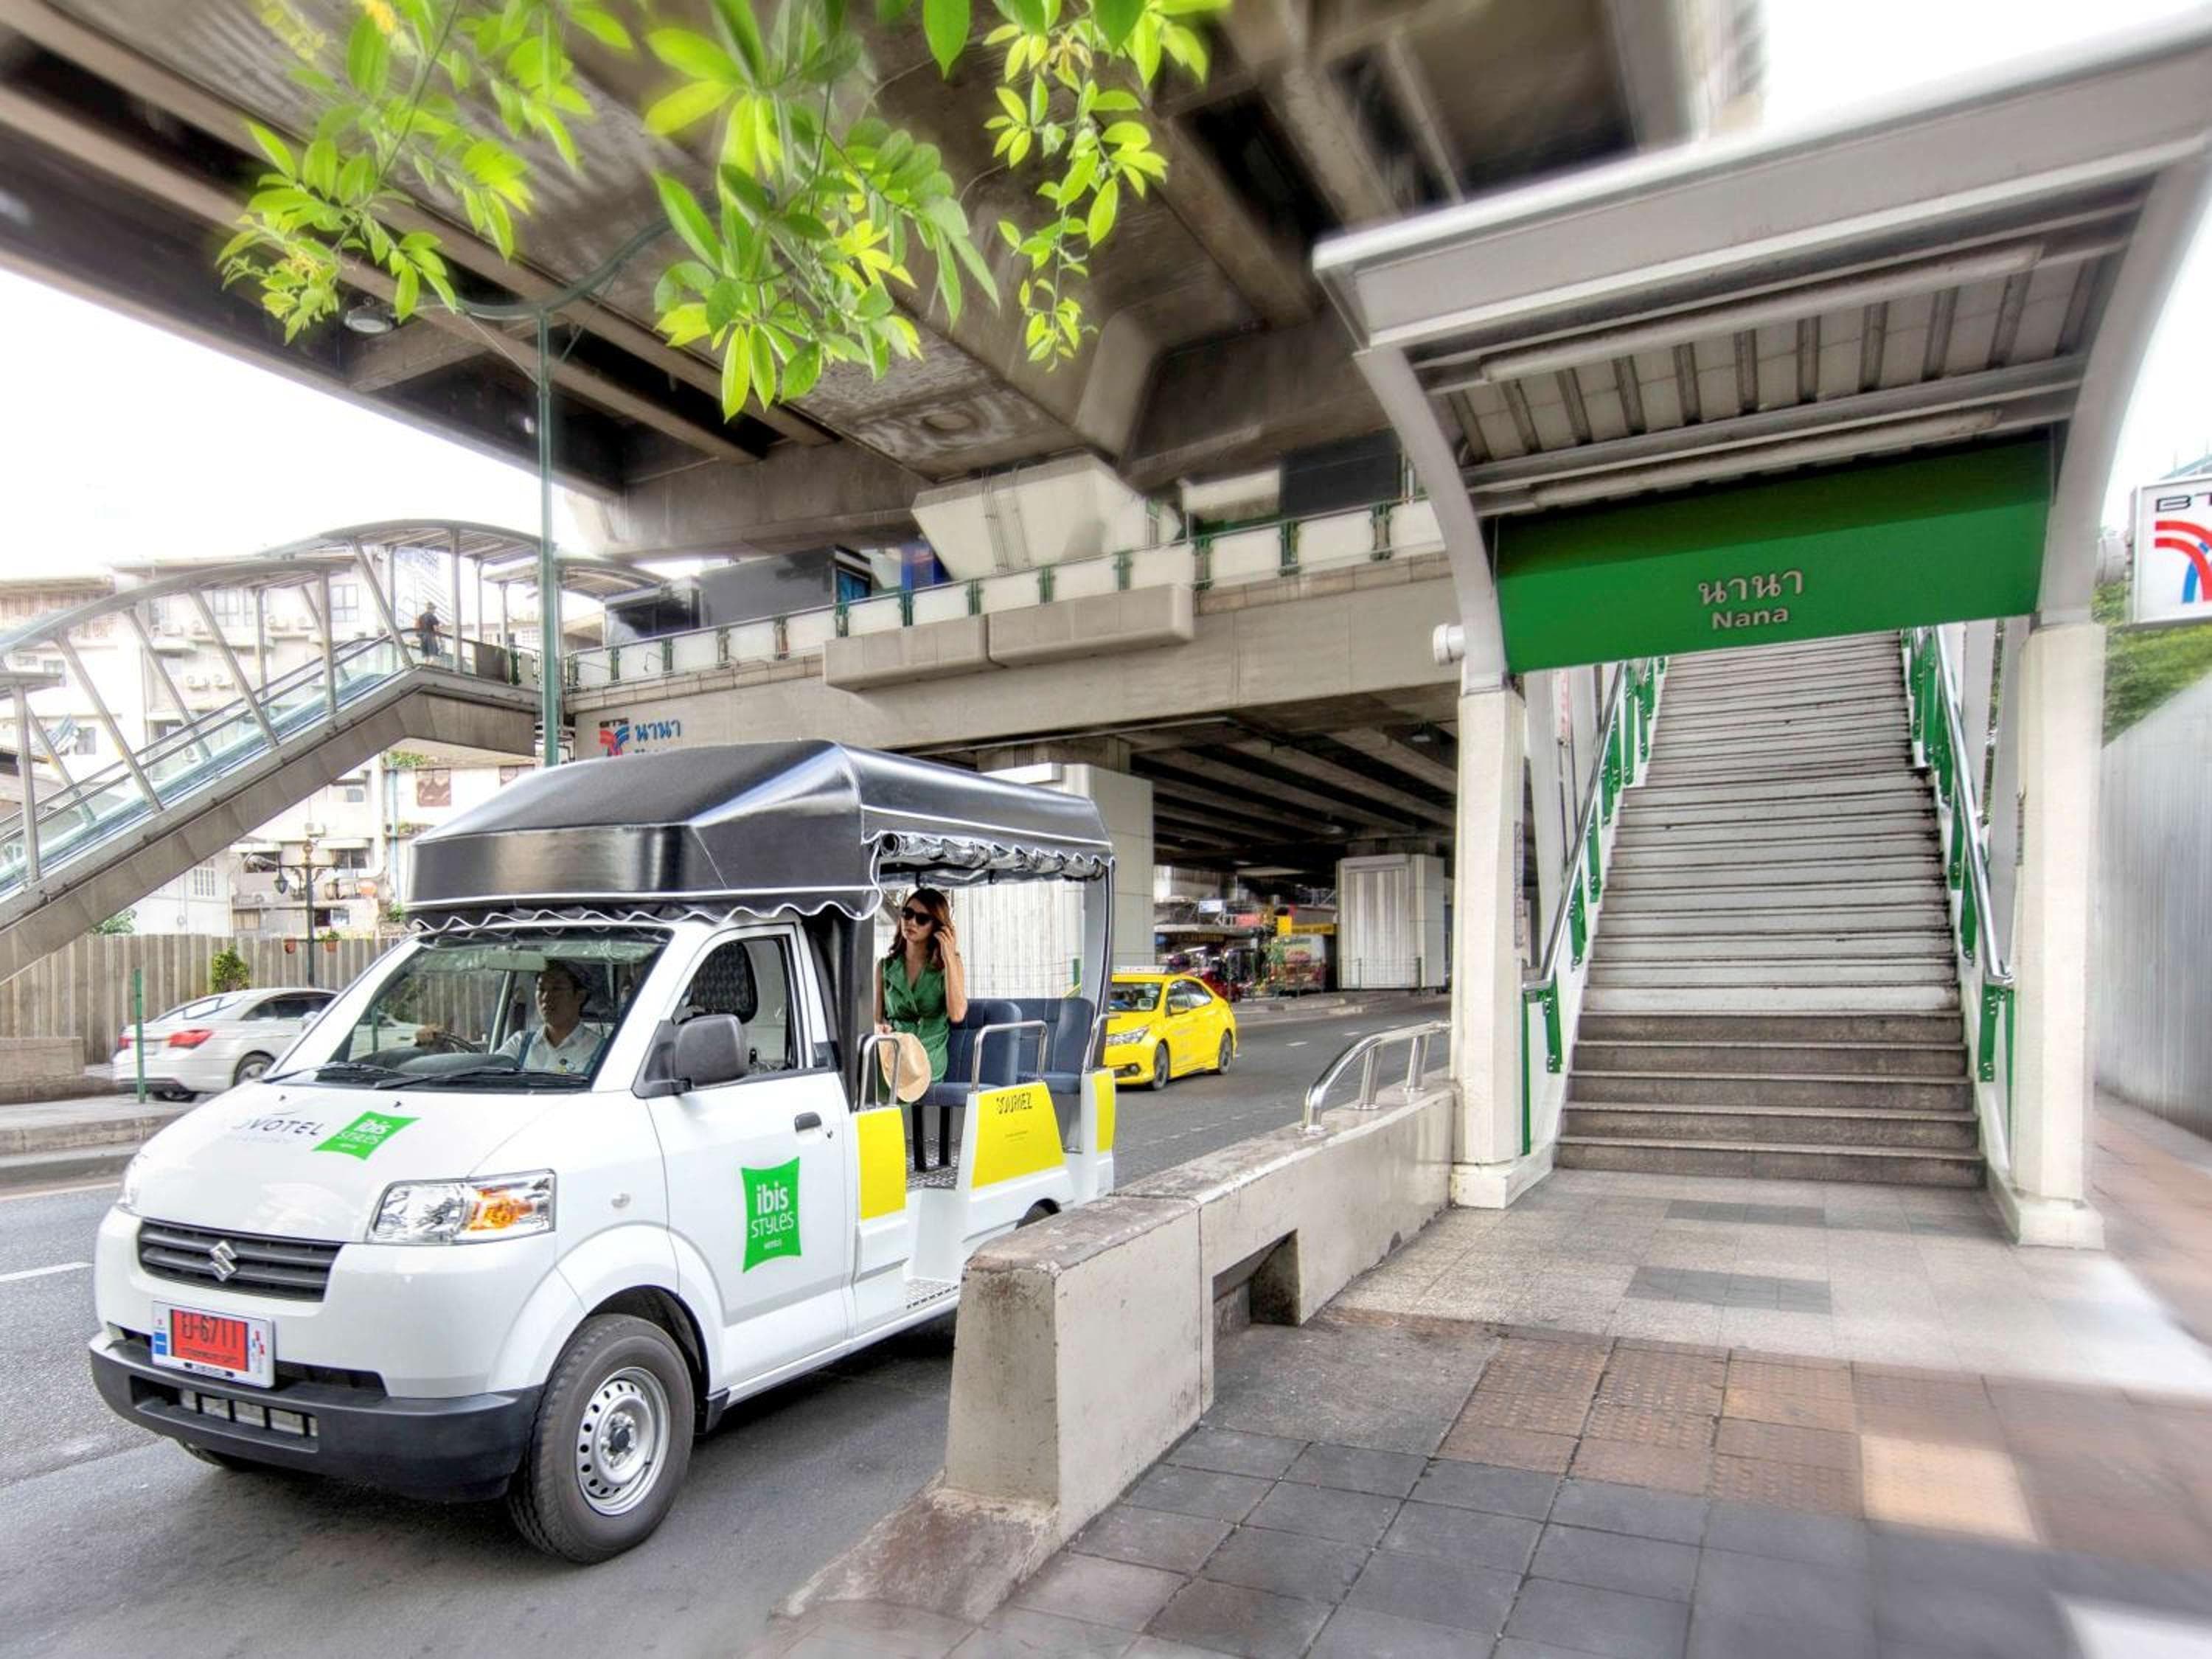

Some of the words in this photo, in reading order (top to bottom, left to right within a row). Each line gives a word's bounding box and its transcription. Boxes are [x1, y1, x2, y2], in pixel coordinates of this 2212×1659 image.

[1698, 570, 1803, 605] นานา
[1711, 608, 1788, 630] Nana
[634, 720, 681, 742] นานา
[757, 1181, 789, 1215] ibis
